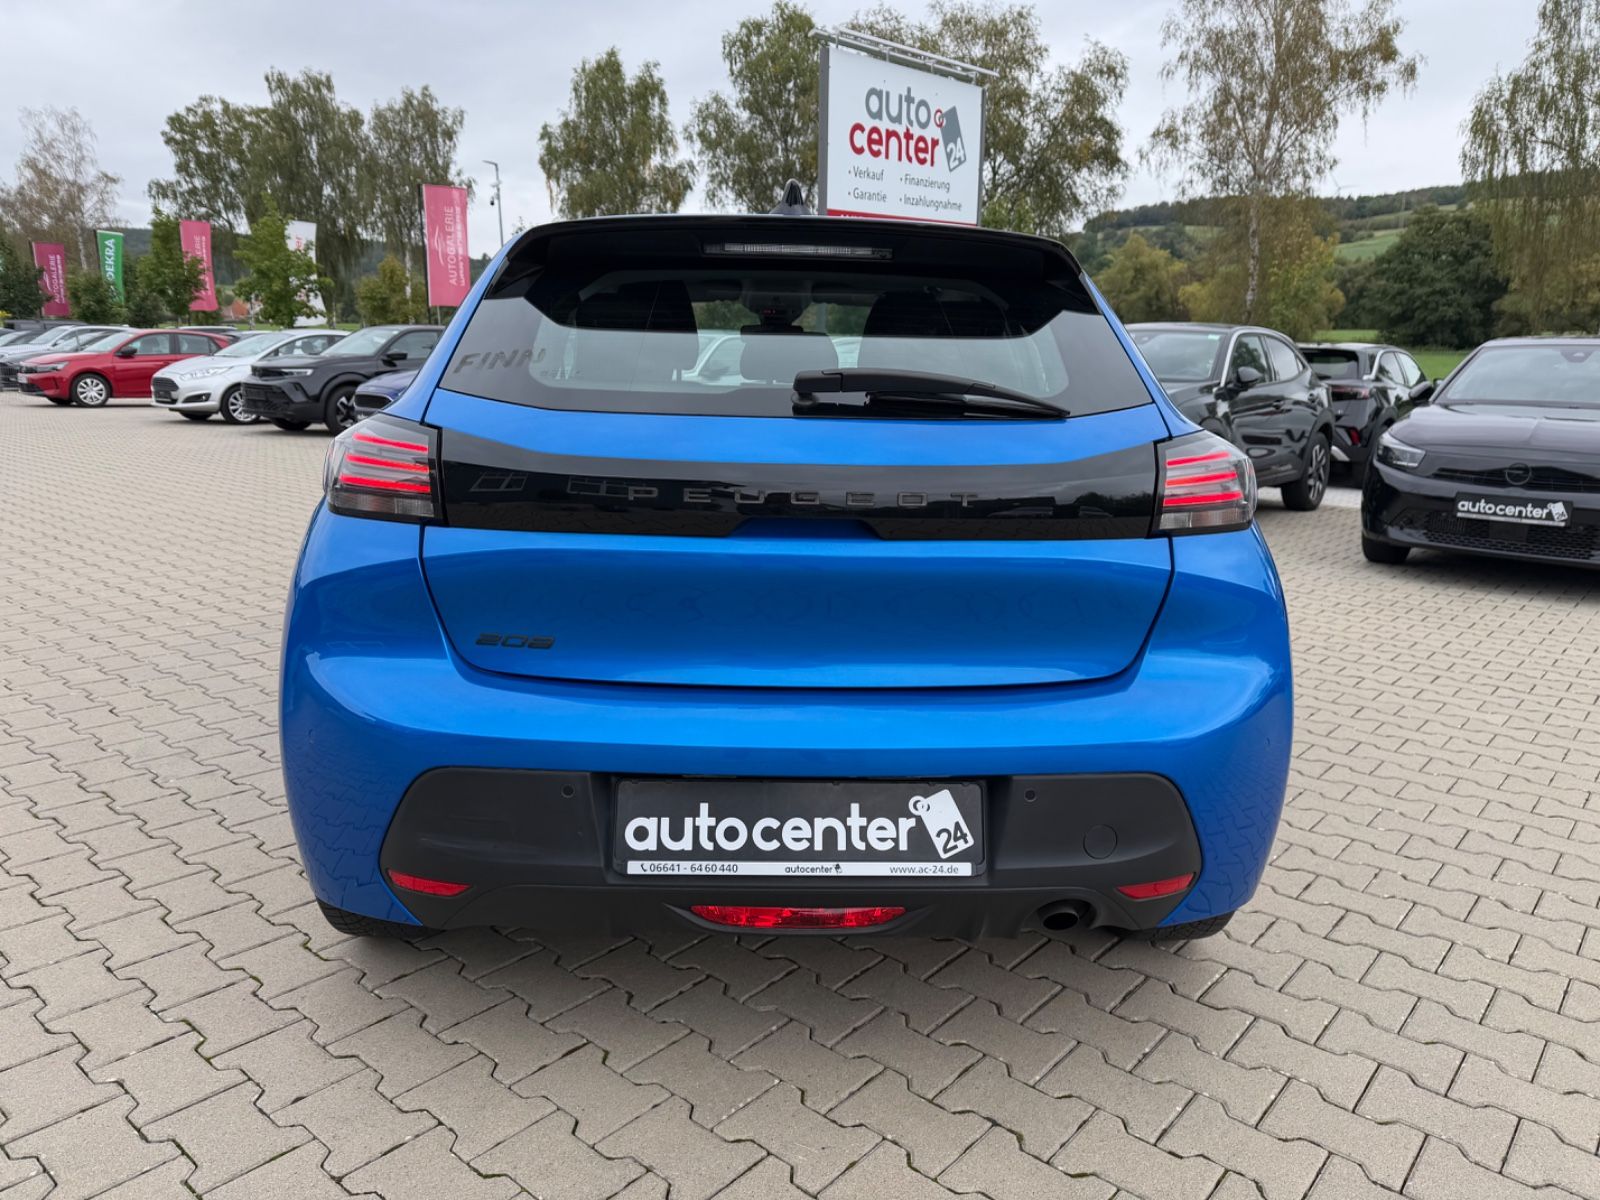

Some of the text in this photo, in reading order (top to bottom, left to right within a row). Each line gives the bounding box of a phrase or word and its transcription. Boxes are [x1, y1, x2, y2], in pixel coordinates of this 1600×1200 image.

[865, 86, 931, 130] auto
[849, 122, 966, 167] center 24
[853, 166, 951, 193] Verkauf Finanzierung
[853, 189, 962, 211] Garantie Inzahlungnahme
[444, 205, 457, 286] AUTOGALERIE
[628, 486, 978, 508] PEUGEOT
[1457, 498, 1550, 519] autocenter
[624, 802, 969, 855] autocenter 24
[649, 863, 681, 873] 06641
[784, 863, 833, 874] autocenter
[889, 864, 959, 875] www.ac-24.de
